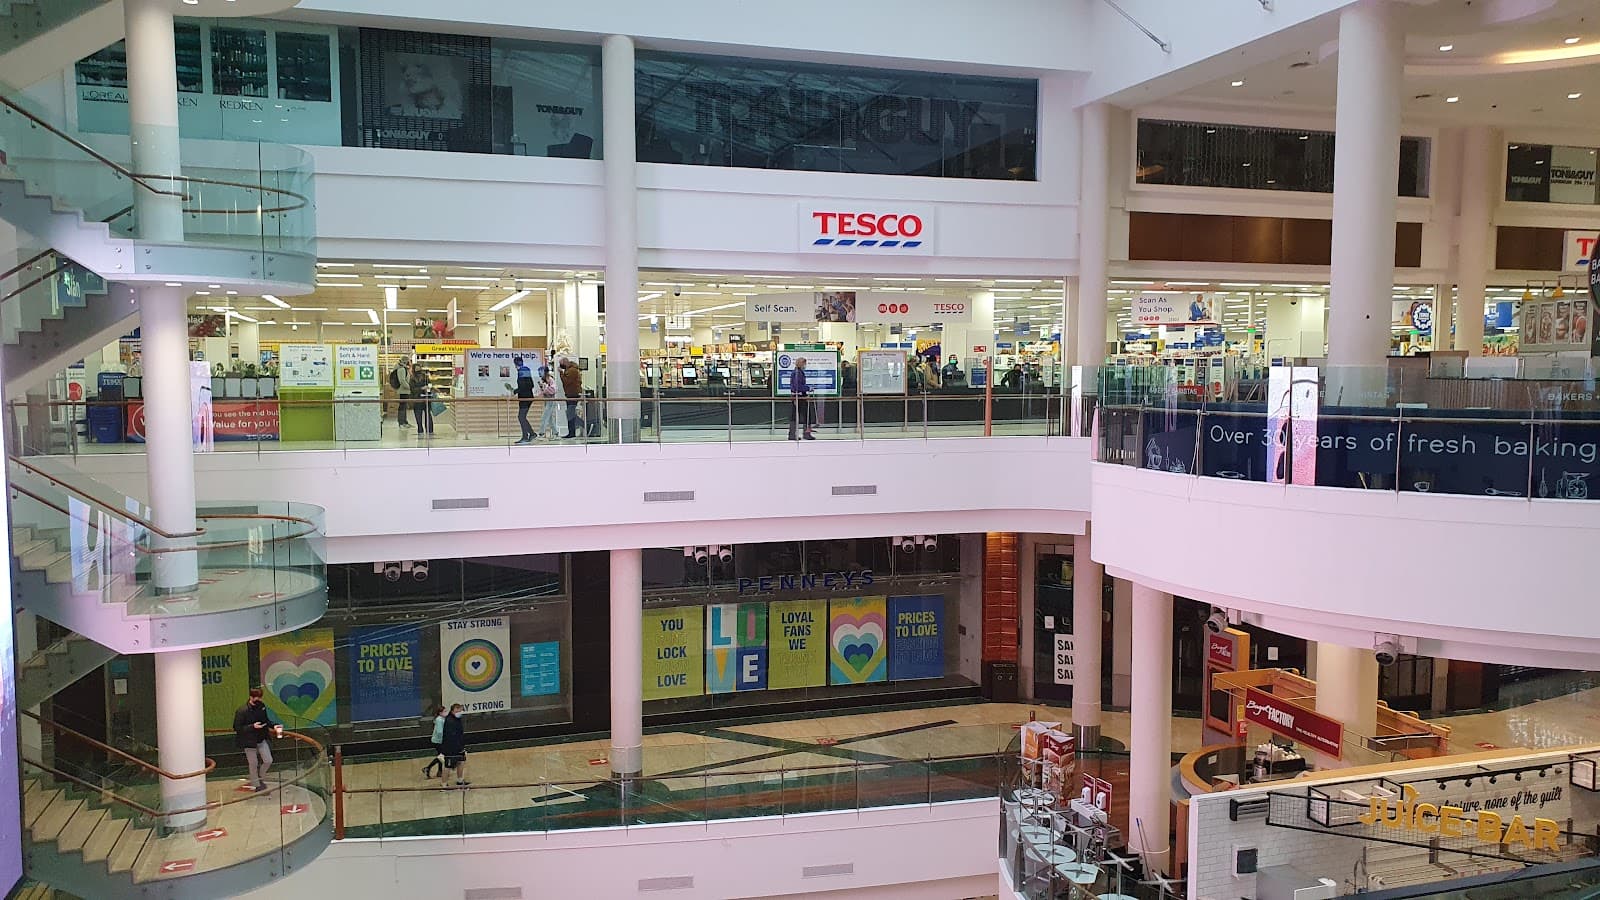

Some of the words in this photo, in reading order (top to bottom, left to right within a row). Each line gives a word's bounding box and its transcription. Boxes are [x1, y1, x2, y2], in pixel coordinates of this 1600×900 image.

[219, 101, 264, 111] REDKEN
[1550, 169, 1595, 179] TONI&GUY
[812, 211, 922, 237] TESCO
[754, 303, 771, 313] Self
[773, 303, 797, 313] Scan.
[933, 303, 965, 311] TESCO
[415, 318, 434, 326] Fruit
[238, 420, 252, 428] for
[1210, 424, 1254, 445] Over
[1260, 428, 1287, 447] 30
[1295, 433, 1357, 450] years
[1370, 432, 1396, 451] of
[1408, 433, 1476, 454] fresh
[1494, 436, 1597, 463] baking
[737, 570, 873, 592] PENNEYS
[447, 620, 468, 630] STAY
[470, 618, 502, 628] STRONG
[781, 611, 814, 624] LOYAL
[898, 611, 935, 624] PRICES
[660, 618, 684, 631] YOU
[784, 625, 811, 637] FANS
[895, 625, 909, 637] TO
[912, 623, 938, 637] LOVE
[360, 642, 409, 657] PRICES
[789, 638, 806, 650] WE
[657, 646, 687, 659] LOCK
[357, 658, 375, 673] TO
[378, 656, 413, 672] LOVE
[657, 674, 687, 688] LOVE
[472, 700, 504, 711] STRONG
[1246, 700, 1271, 716] Bagel
[1267, 706, 1295, 728] FACTORY
[1484, 796, 1509, 811] none
[1510, 791, 1523, 810] of
[1523, 790, 1538, 804] the
[1540, 786, 1563, 809] guilt
[1477, 809, 1561, 852] BAR
